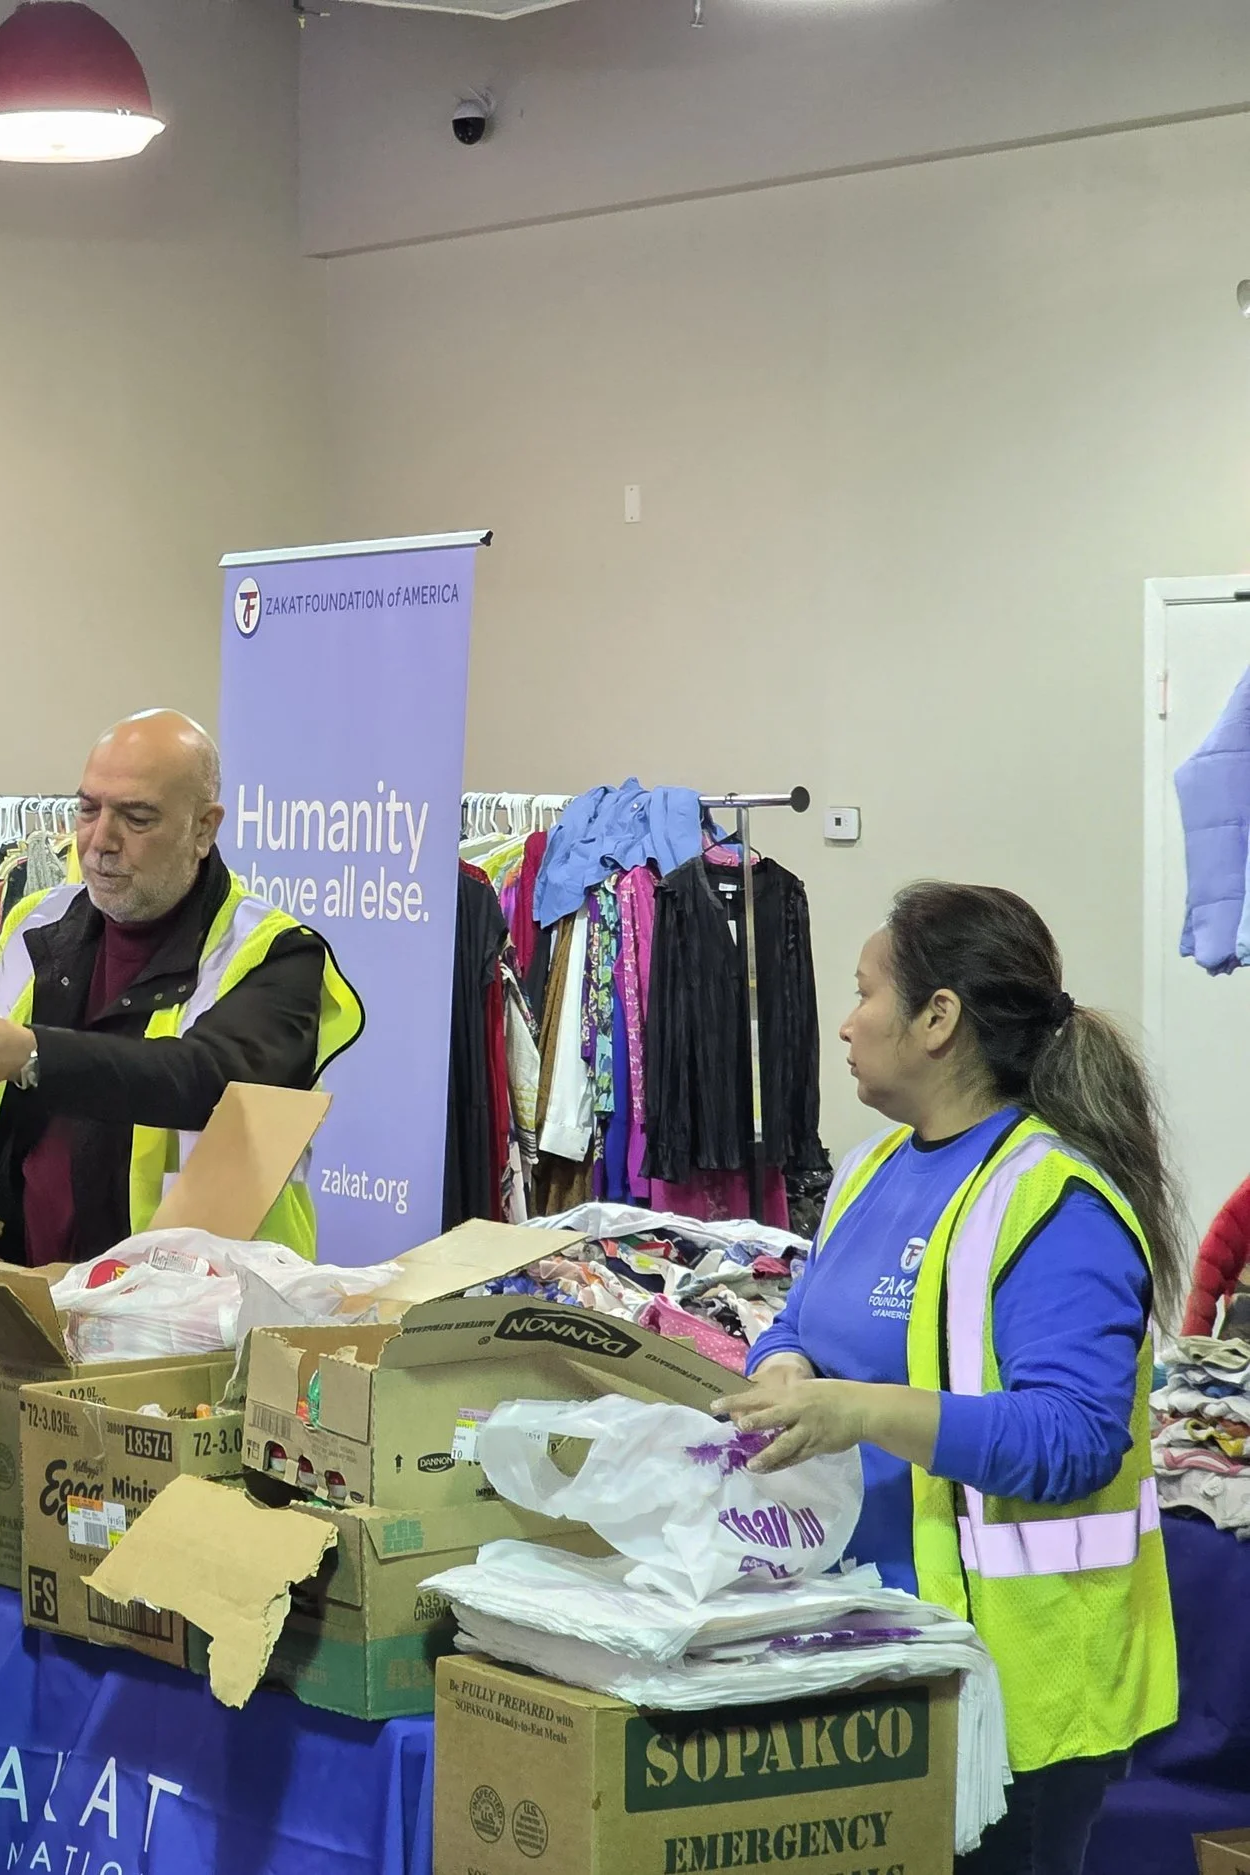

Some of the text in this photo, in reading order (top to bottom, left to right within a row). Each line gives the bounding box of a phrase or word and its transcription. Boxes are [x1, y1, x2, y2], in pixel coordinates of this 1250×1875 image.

[266, 583, 459, 615] ZAKAT FOUNDATION of AMERICA
[236, 780, 428, 873] Humanity
[323, 865, 355, 918] all
[360, 866, 429, 923] else.
[321, 1163, 409, 1214] zakat.org
[868, 1295, 913, 1309] FOUNDAT
[880, 1309, 911, 1321] AMERIC
[506, 1317, 628, 1355] DANNON
[27, 1403, 63, 1433] 72-3.03
[126, 1428, 171, 1460] 18574
[193, 1427, 243, 1456] 72-3.0
[420, 1456, 453, 1468] DANNON
[112, 1475, 157, 1504] Minis
[70, 1548, 87, 1564] Store
[31, 1574, 55, 1616] FS
[450, 1679, 575, 1728] Be FULLY PREPARED with
[455, 1700, 568, 1744] SOPAKCO Ready-to-Eat Meals
[646, 1706, 913, 1788] SOPAKCO
[664, 1811, 893, 1875] EMERGENCY
